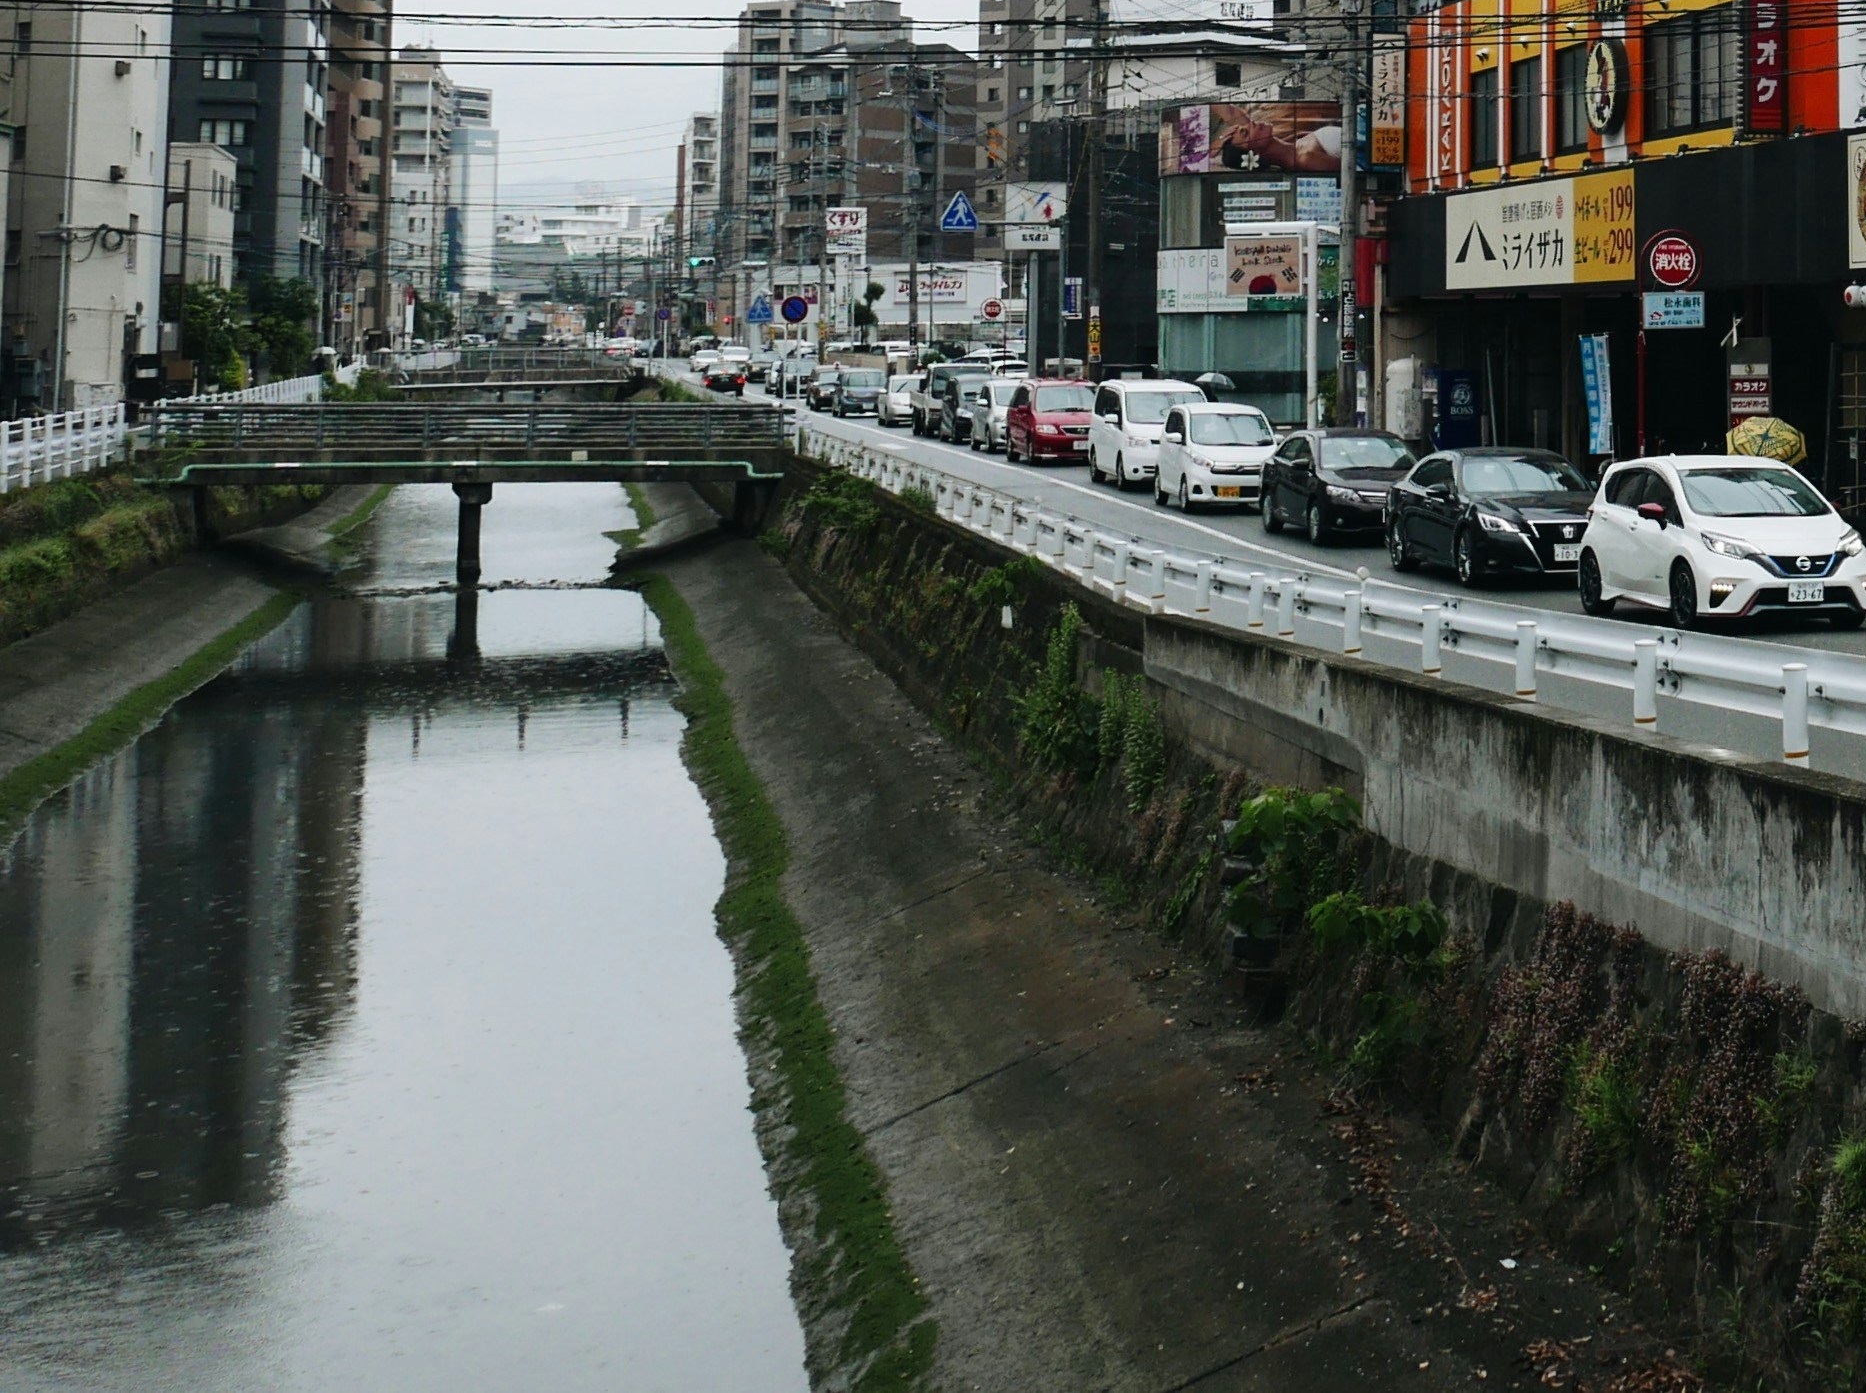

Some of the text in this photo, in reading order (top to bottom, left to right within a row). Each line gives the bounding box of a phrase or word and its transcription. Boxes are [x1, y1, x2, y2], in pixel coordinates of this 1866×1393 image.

[1377, 54, 1390, 121] ミライザカ
[828, 211, 860, 226] くすり
[1502, 228, 1563, 271] ミライザカ
[1574, 235, 1601, 265] 生ビール
[1655, 252, 1691, 271] 消火栓
[1734, 381, 1767, 392] カラオケ
[1450, 406, 1474, 415] BOSS
